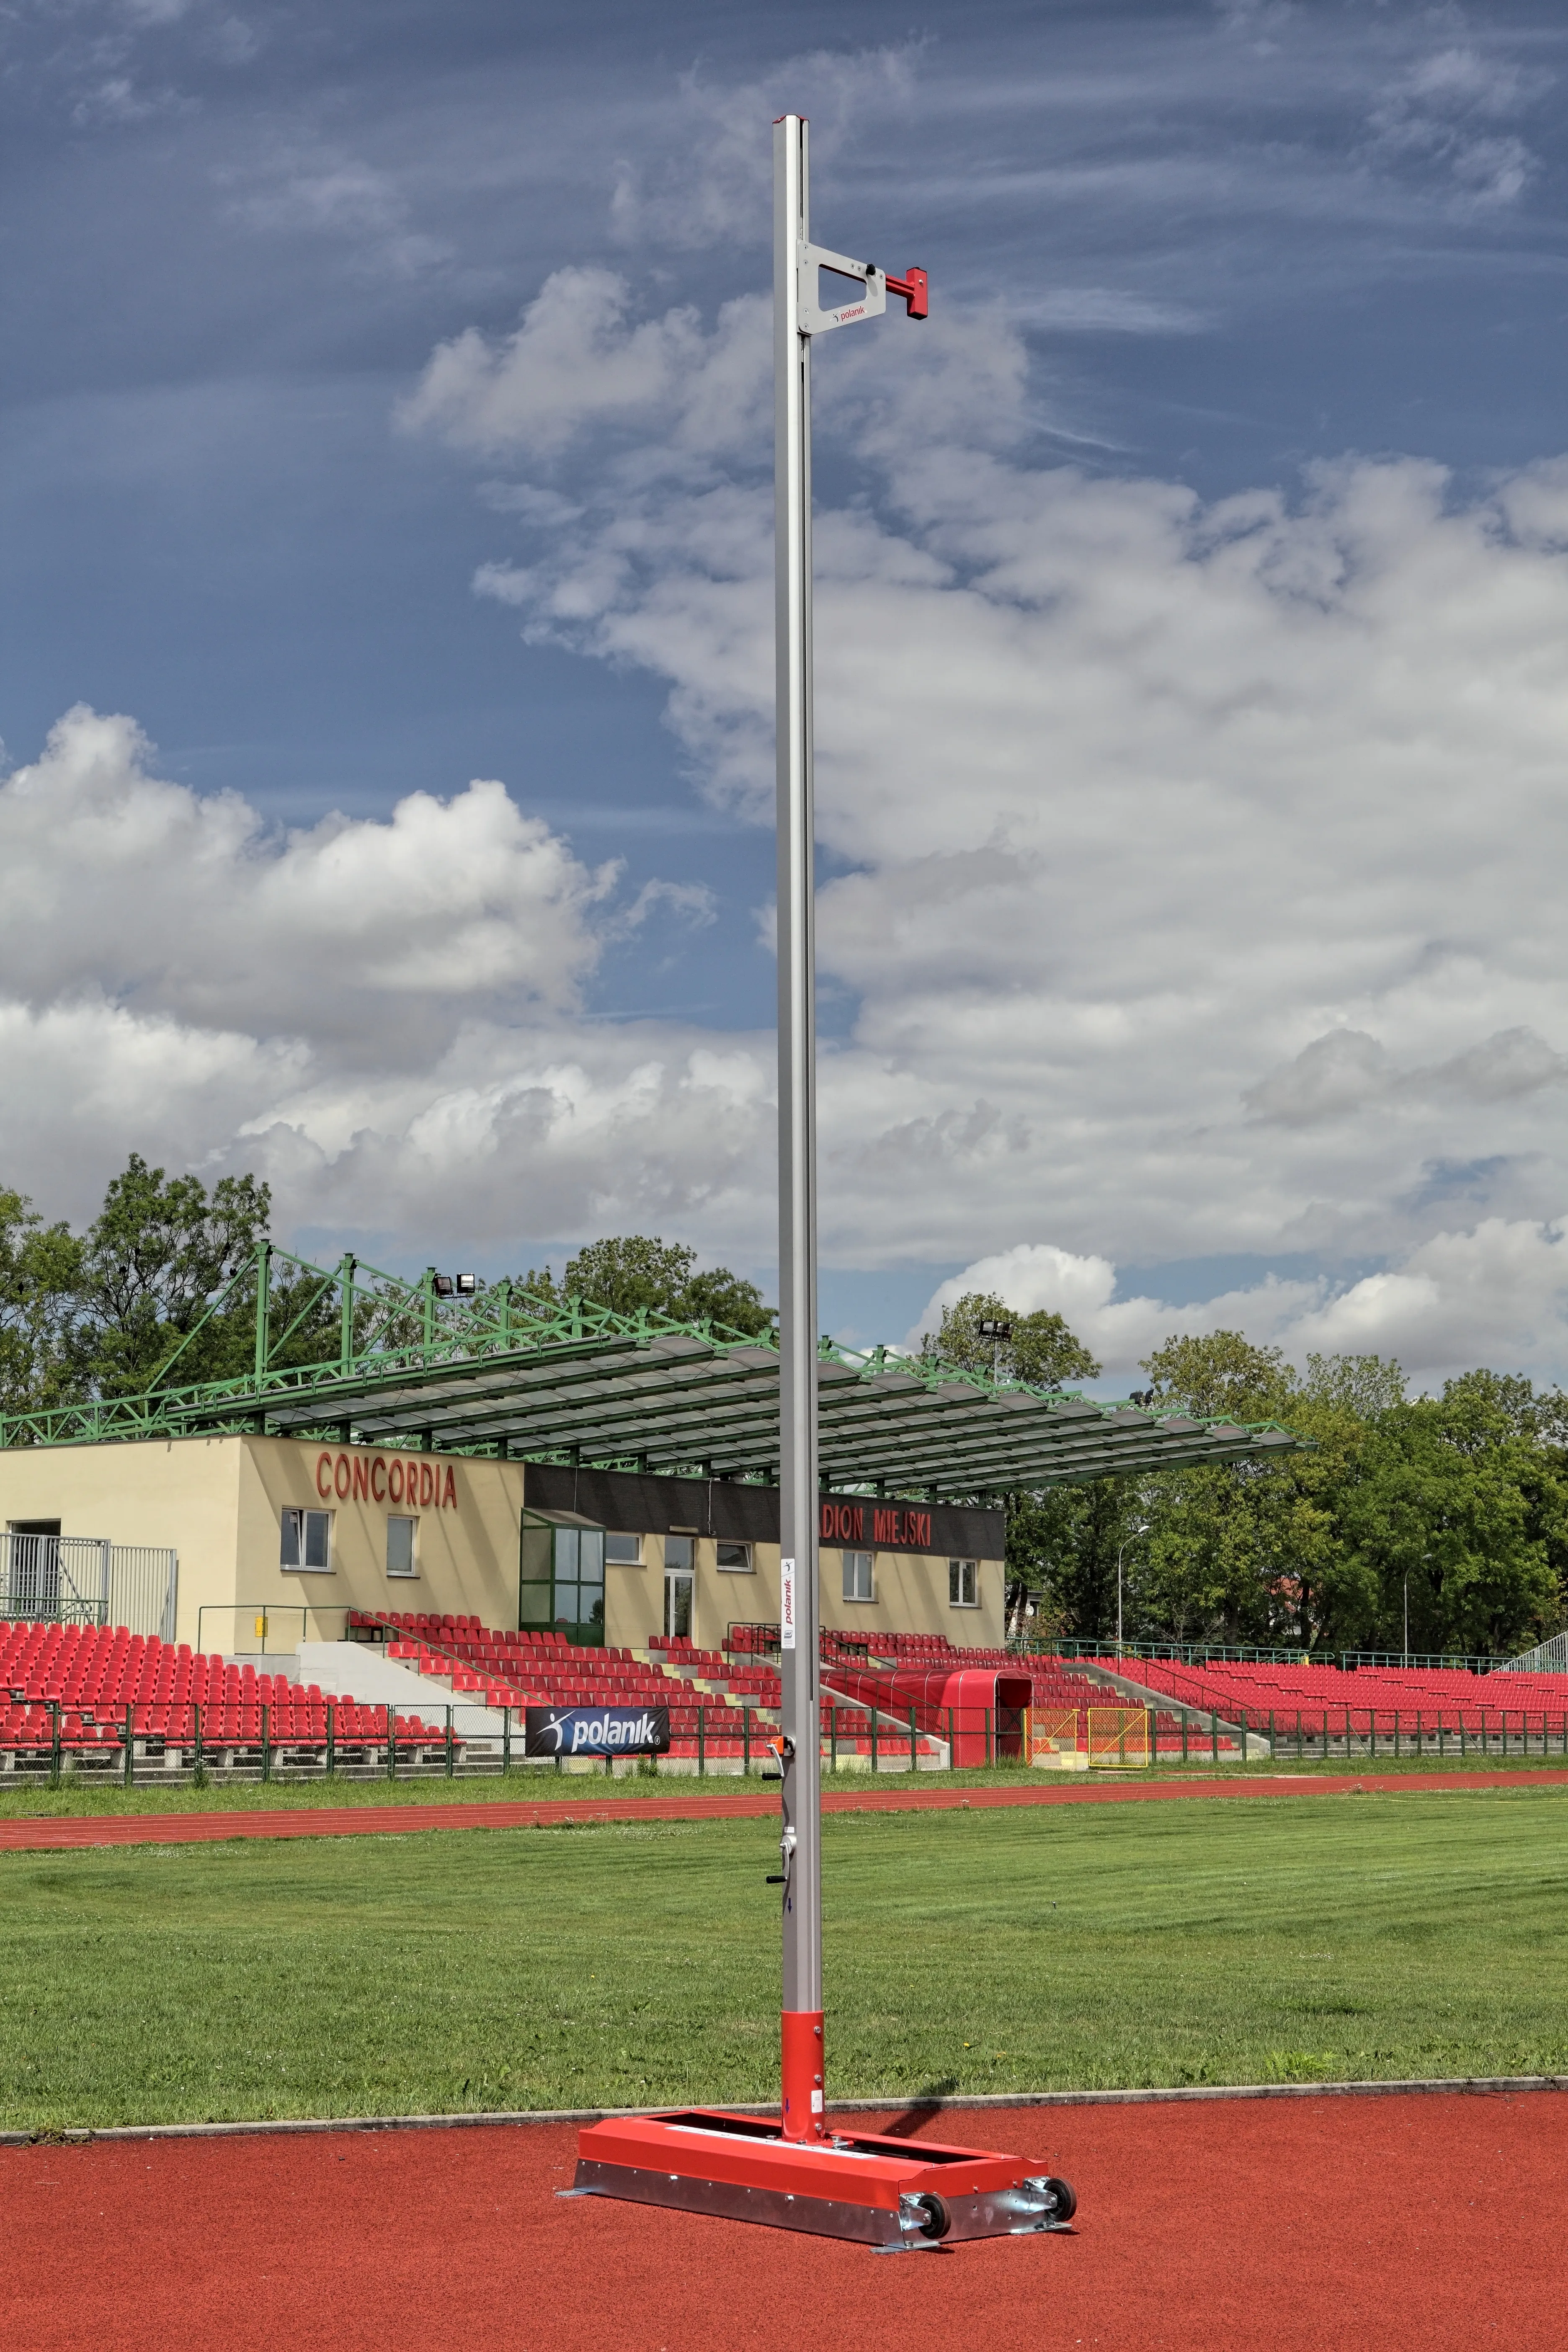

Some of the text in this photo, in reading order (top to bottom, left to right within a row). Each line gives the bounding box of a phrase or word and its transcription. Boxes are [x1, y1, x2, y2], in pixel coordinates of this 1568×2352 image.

[841, 305, 865, 322] polanik
[316, 1452, 457, 1508] CONCORDIA
[819, 1504, 931, 1547] DION MIEJSKI
[784, 1578, 793, 1625] polanik
[571, 1712, 655, 1753] polanik
